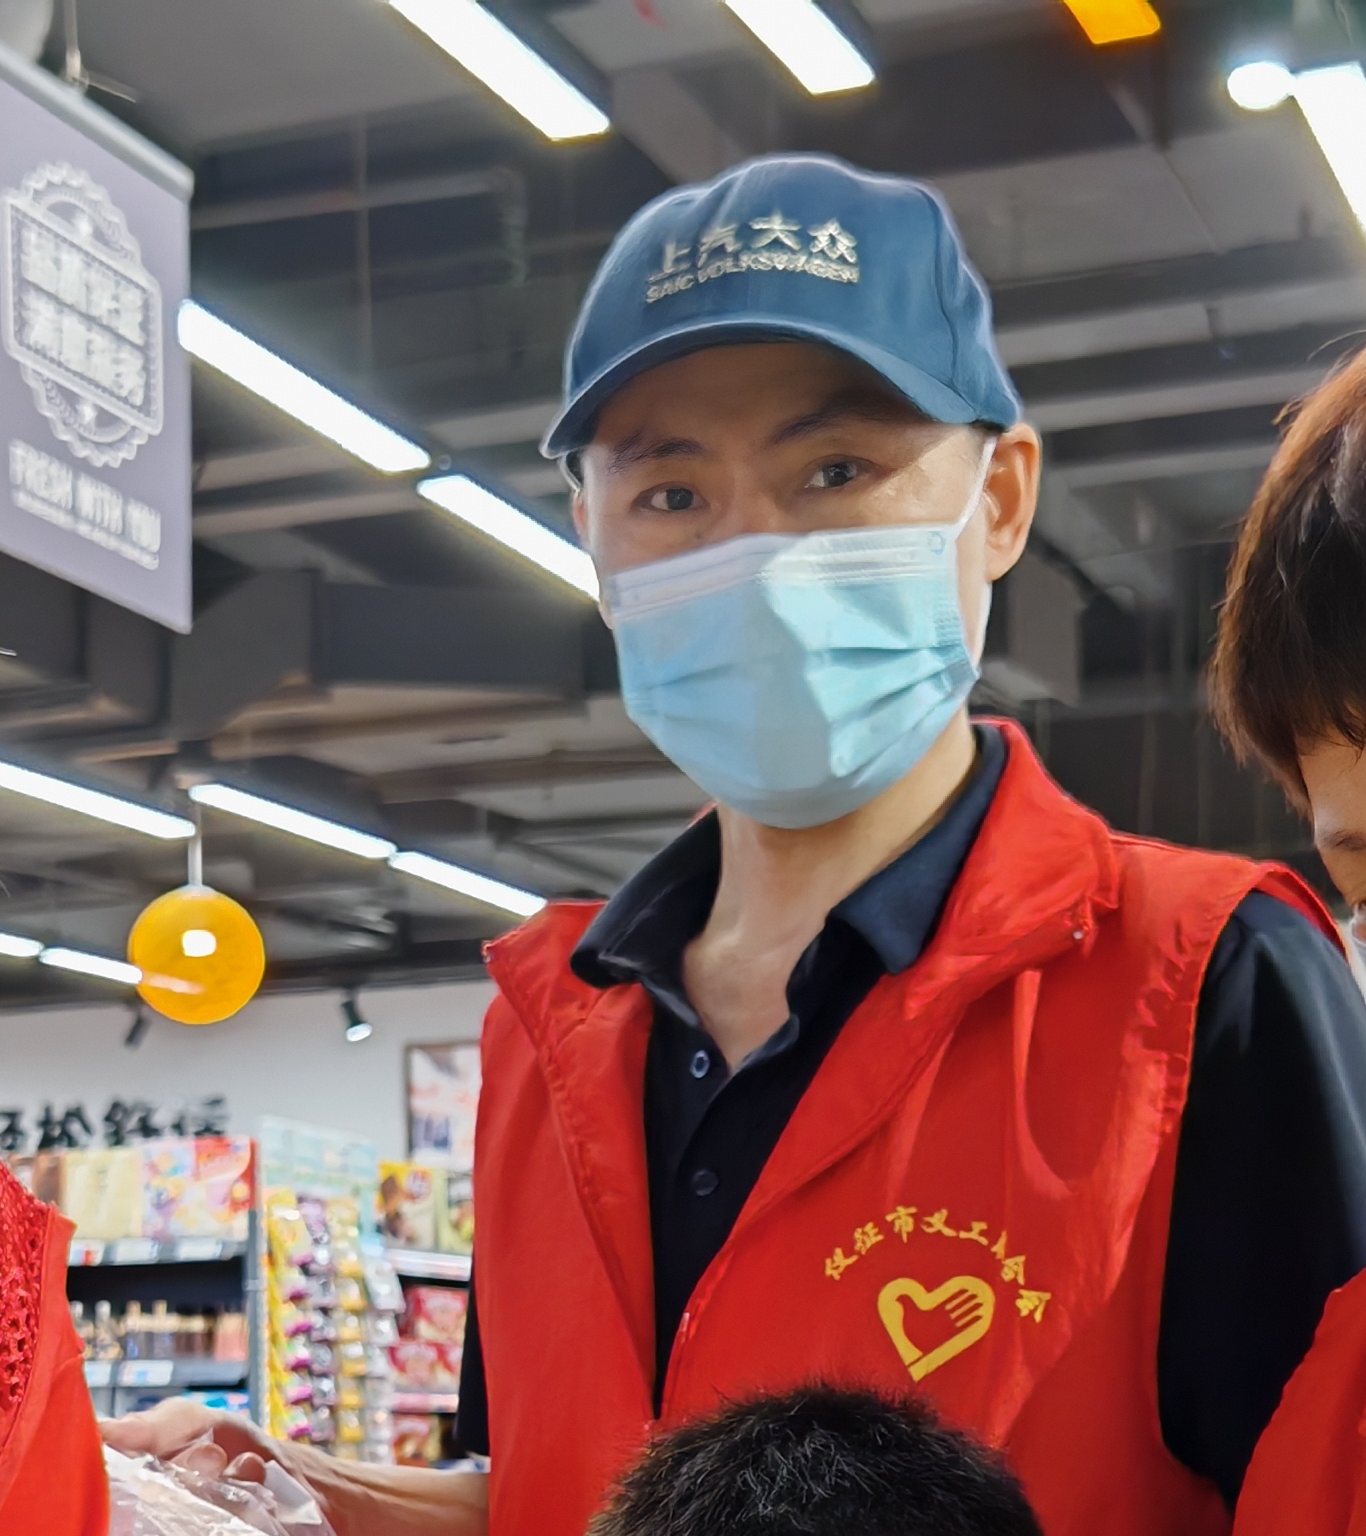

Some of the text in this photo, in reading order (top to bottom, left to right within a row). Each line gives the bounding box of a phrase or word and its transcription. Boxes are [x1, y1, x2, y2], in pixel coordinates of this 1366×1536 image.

[824, 1205, 1052, 1324] 仪征市义工合会
